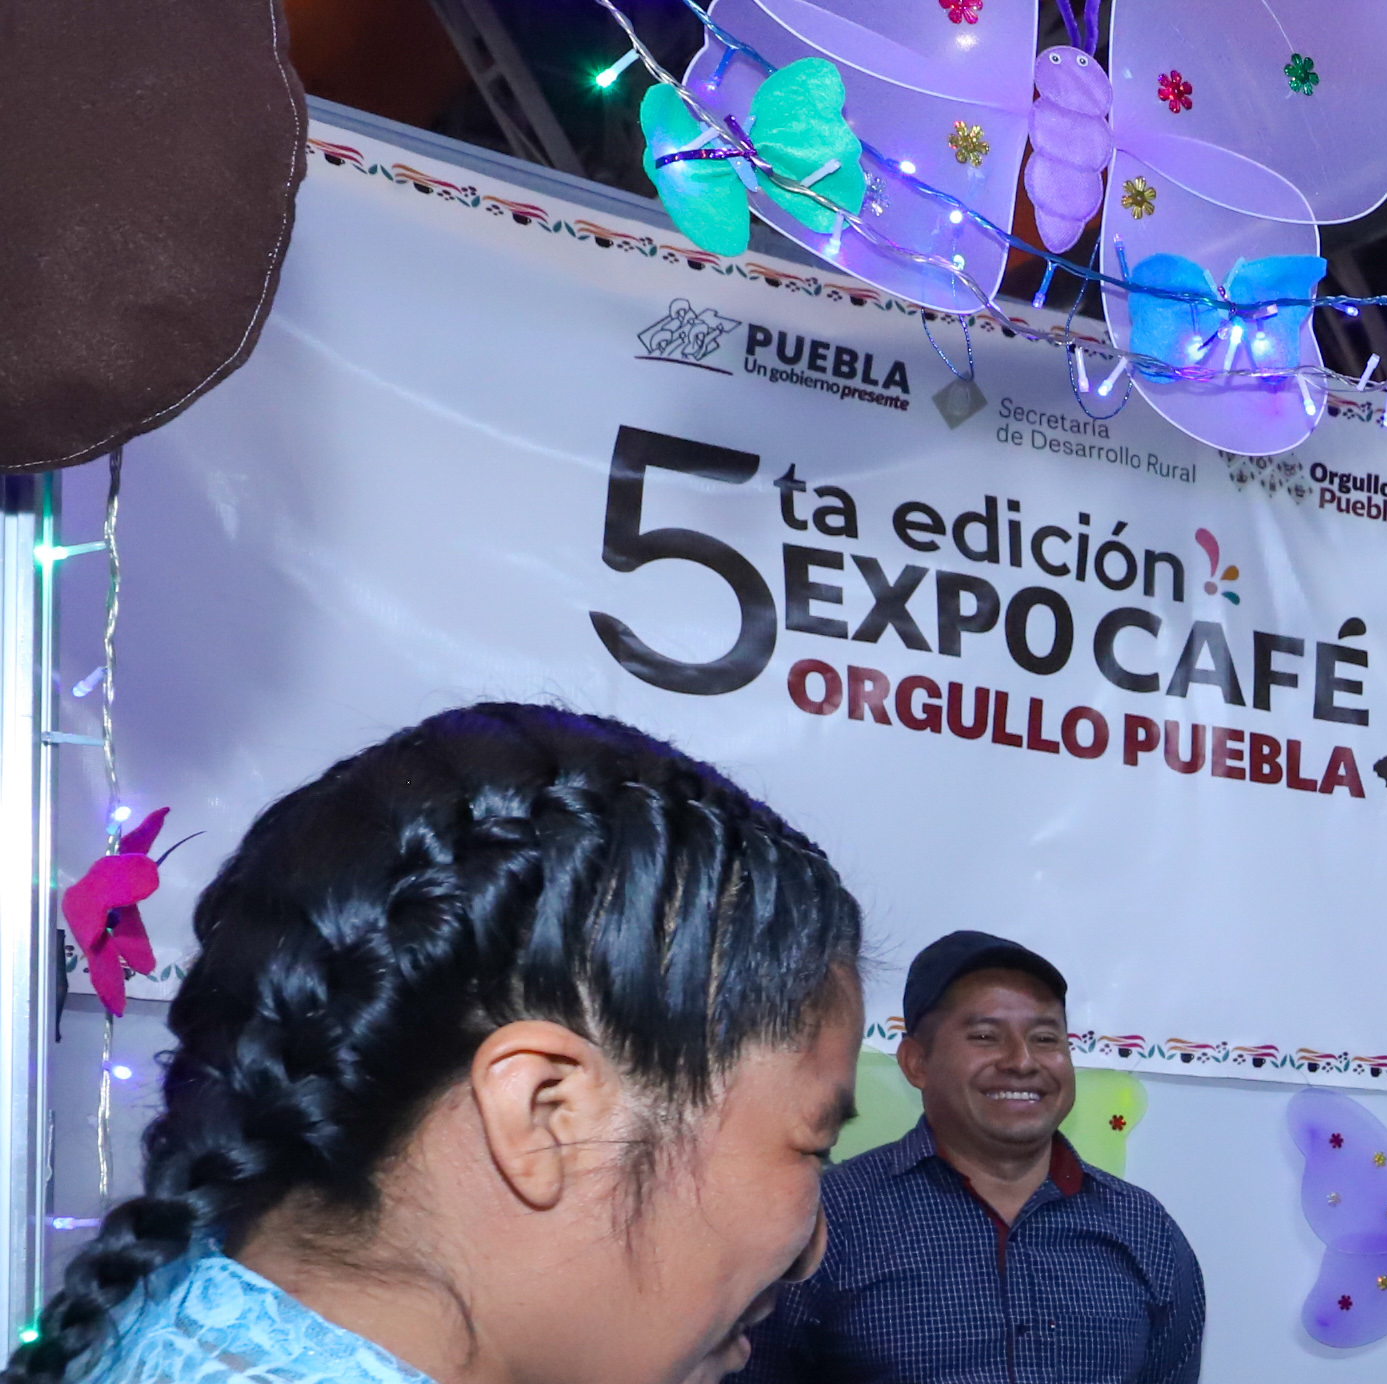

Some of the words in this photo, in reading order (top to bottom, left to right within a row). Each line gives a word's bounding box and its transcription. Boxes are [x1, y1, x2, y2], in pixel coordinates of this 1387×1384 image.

[744, 357, 767, 377] Un
[769, 367, 839, 394] gobierno
[840, 387, 910, 411] presente
[745, 324, 910, 395] PUEBLA
[996, 424, 1023, 446] de
[1031, 430, 1141, 470] Desarrollo
[1147, 454, 1196, 483] Rural
[999, 397, 1110, 439] Secretaría
[892, 496, 1185, 602] edición
[782, 543, 1075, 676] EXPO
[1091, 617, 1371, 727] CAFÉ
[787, 658, 1109, 758] ORGULLO
[1124, 715, 1367, 801] PUEBLA
